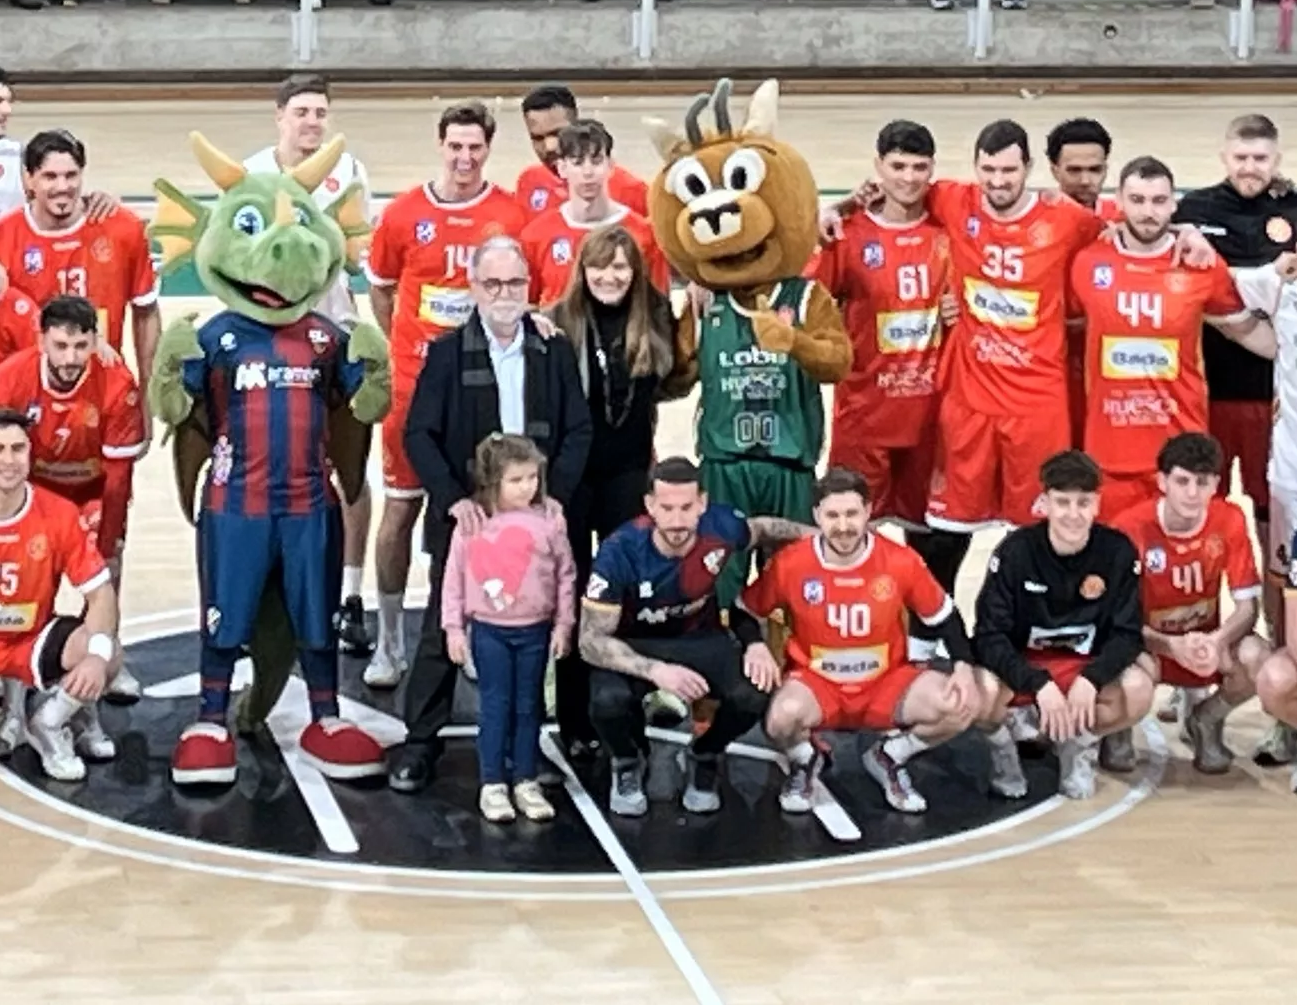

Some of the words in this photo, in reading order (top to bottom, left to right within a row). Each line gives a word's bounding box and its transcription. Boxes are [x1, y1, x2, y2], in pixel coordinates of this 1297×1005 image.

[444, 245, 477, 280] 14
[981, 245, 1023, 282] 35
[56, 267, 88, 298] 13
[898, 264, 929, 301] 61
[1118, 291, 1162, 329] 44
[54, 427, 72, 457] 7
[733, 410, 781, 448] 00
[1172, 565, 1205, 595] 41
[827, 602, 871, 639] 40
